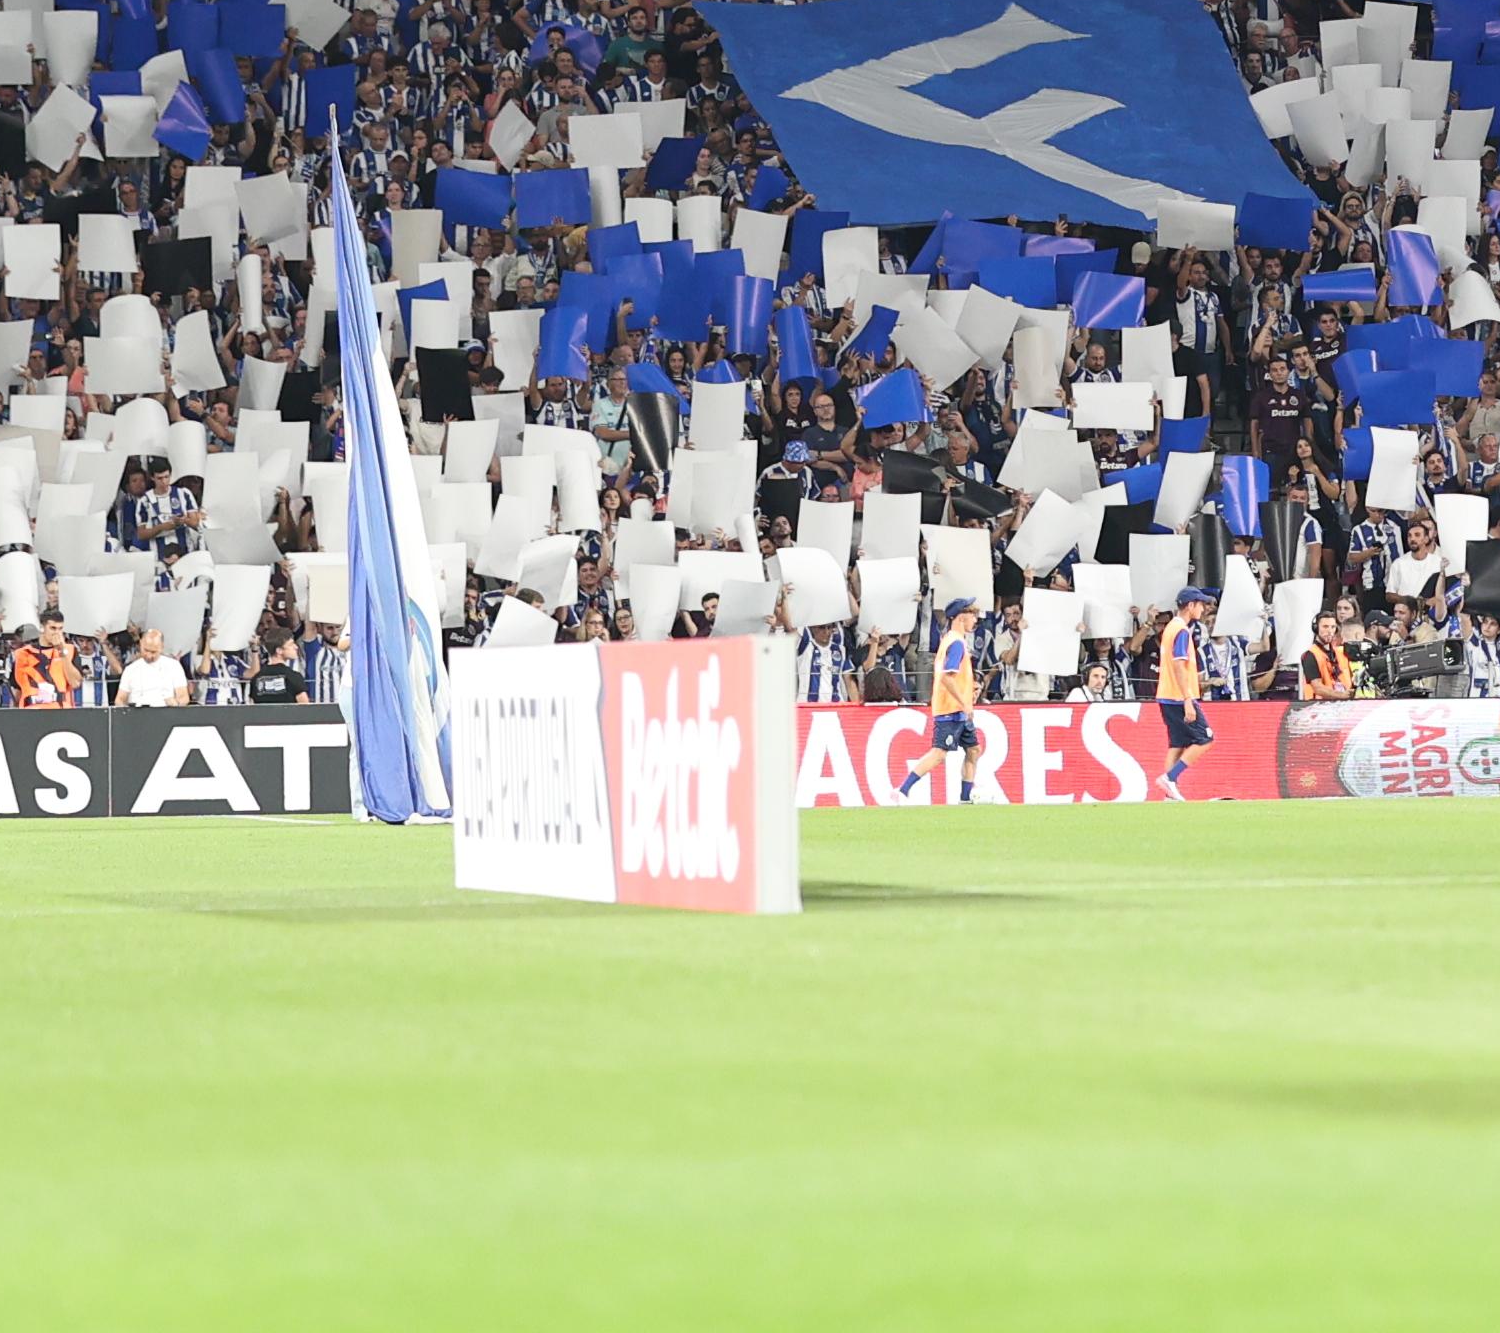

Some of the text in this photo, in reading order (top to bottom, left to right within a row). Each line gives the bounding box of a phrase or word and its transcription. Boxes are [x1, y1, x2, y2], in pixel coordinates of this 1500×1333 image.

[1271, 408, 1299, 418] Betano
[1100, 460, 1128, 470] Betano
[131, 724, 349, 814] AT
[797, 702, 1149, 808] AGRES
[1409, 703, 1453, 797] SAGR
